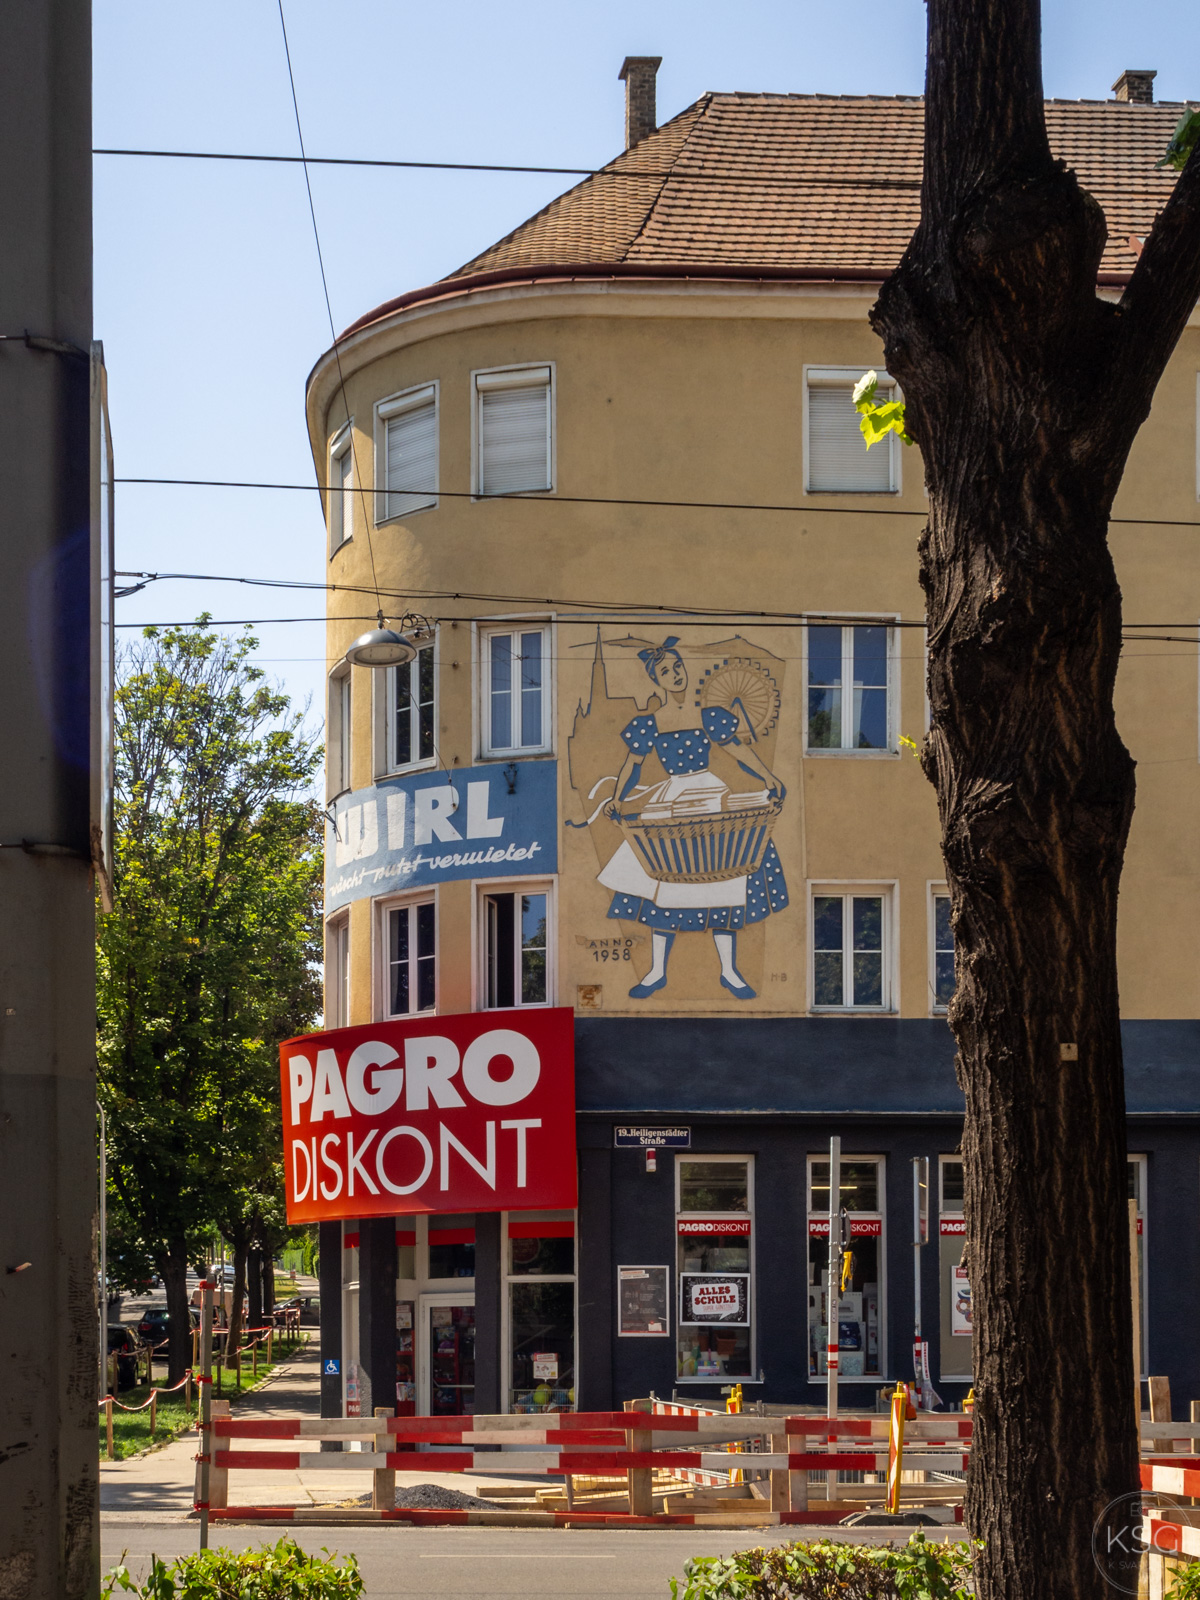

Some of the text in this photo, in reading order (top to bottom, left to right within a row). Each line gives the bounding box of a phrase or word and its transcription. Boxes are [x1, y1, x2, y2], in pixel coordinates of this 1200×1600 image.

[336, 780, 504, 868] WIRL
[589, 939, 633, 948] ANNO
[592, 948, 632, 962] 1958
[288, 1029, 541, 1126] PAGRO
[639, 1136, 666, 1145] Straße
[292, 1118, 542, 1203] DISKONT
[809, 1223, 880, 1232] PAG SKONT
[698, 1286, 731, 1295] ALLES
[694, 1295, 736, 1305] SCHULE
